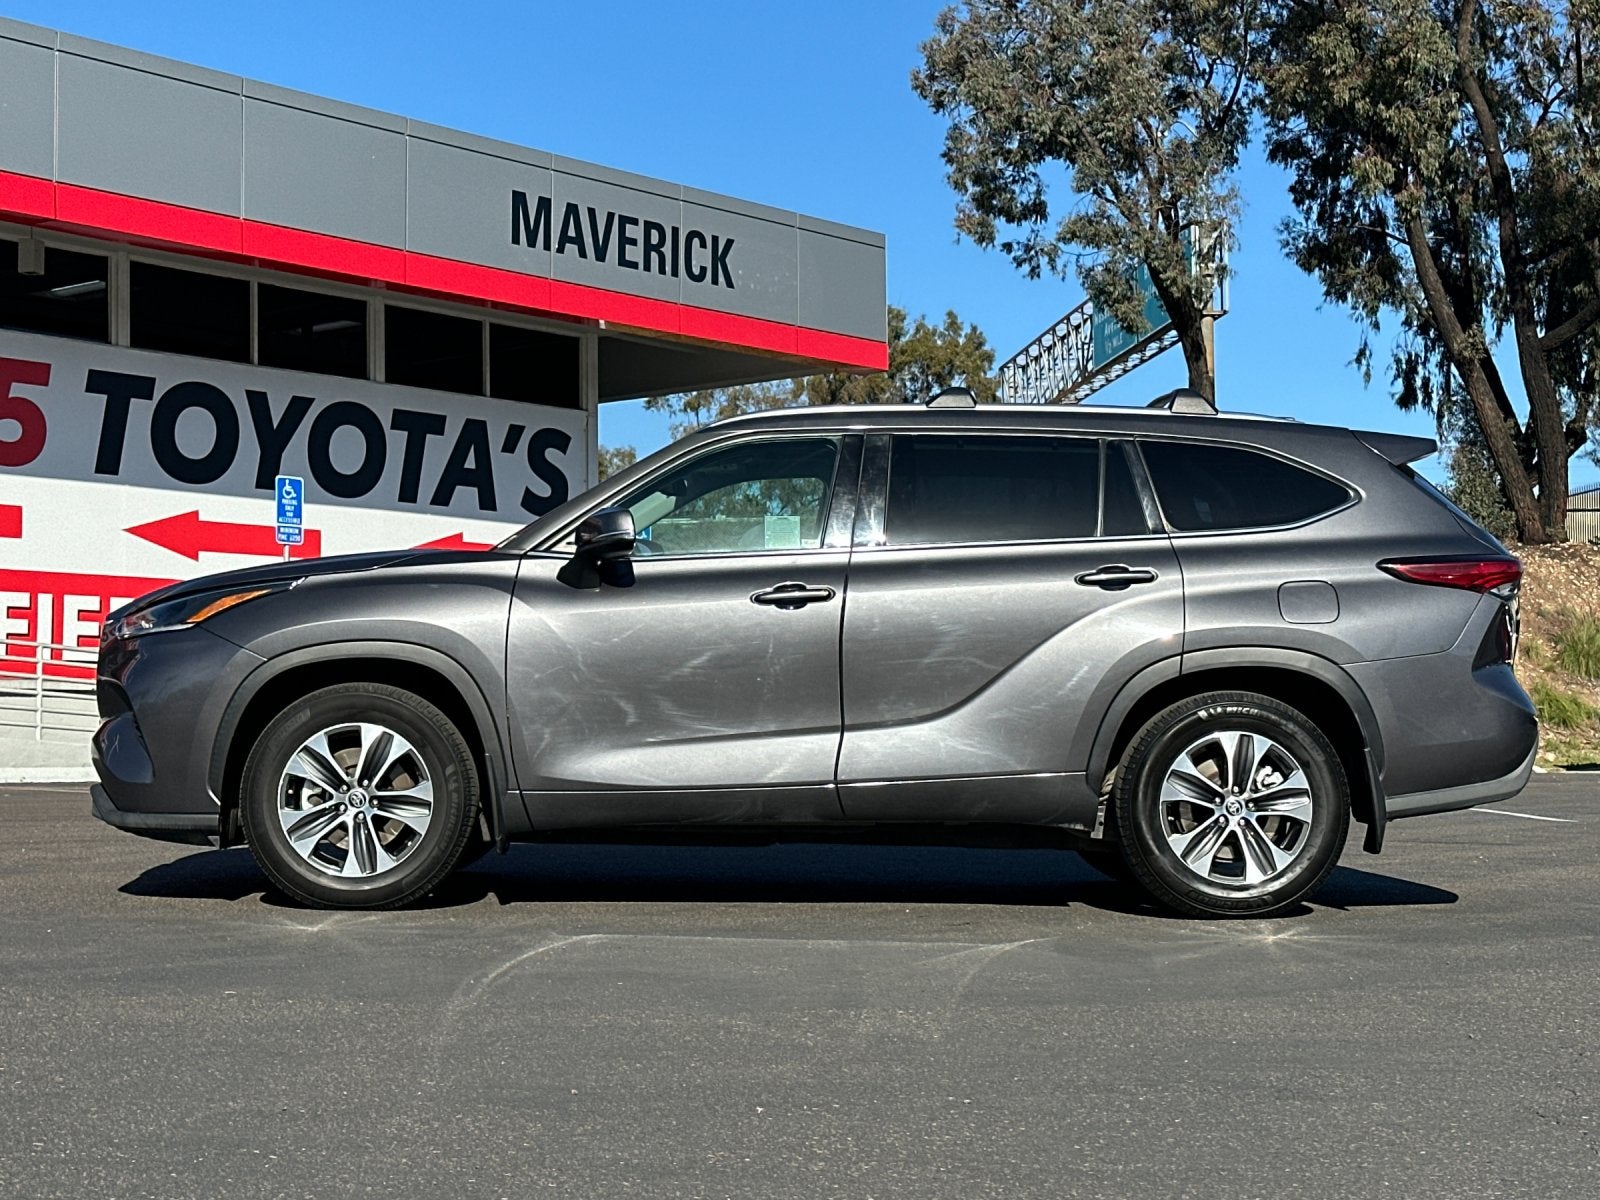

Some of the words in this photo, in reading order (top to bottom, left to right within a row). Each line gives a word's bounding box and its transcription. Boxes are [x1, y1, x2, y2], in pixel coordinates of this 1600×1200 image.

[511, 189, 735, 290] MAVERICK
[0, 357, 52, 467] 5
[85, 368, 571, 517] TOYOTA'S
[0, 591, 136, 662] FIE
